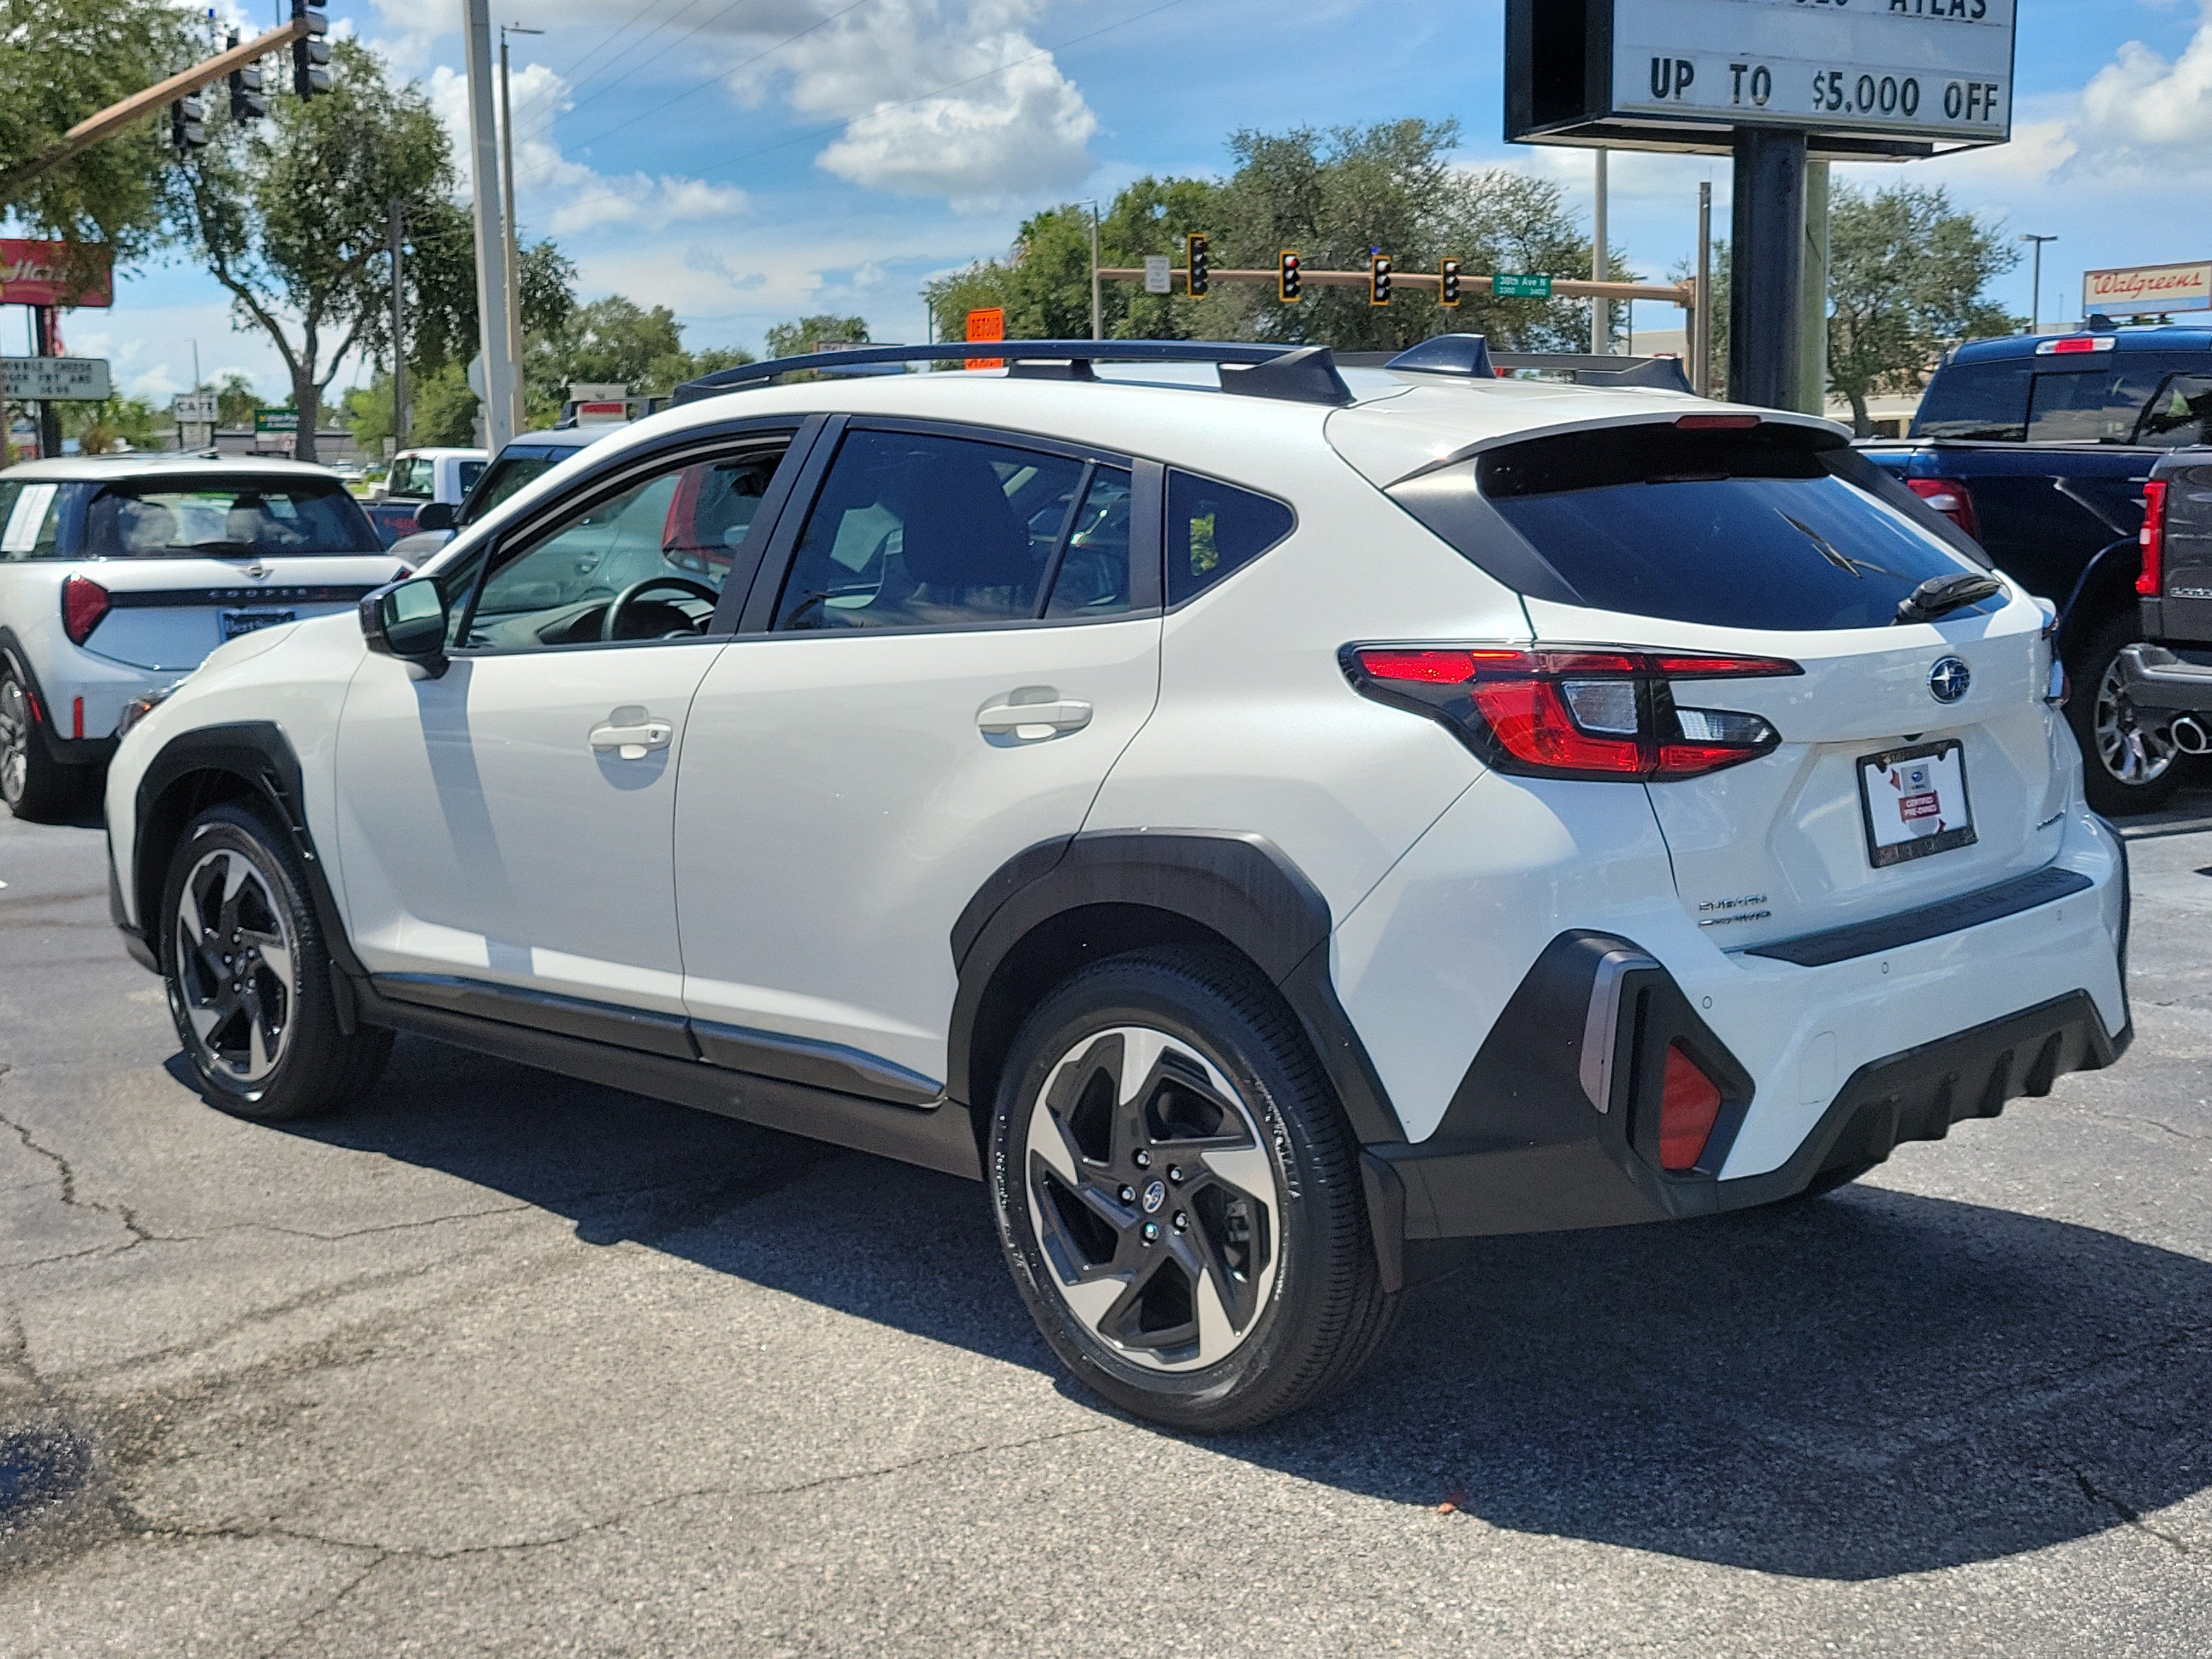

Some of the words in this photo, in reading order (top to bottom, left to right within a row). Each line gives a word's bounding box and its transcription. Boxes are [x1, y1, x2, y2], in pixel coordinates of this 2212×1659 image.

[1651, 58, 1695, 99] UP
[1730, 64, 1771, 105] TO
[1813, 70, 1919, 117] $5,000
[1944, 82, 1998, 121] OFF
[1499, 276, 1519, 285] 38th
[1522, 277, 1537, 286] Ave
[1540, 278, 1547, 286] N
[2094, 272, 2202, 299] Walgreens
